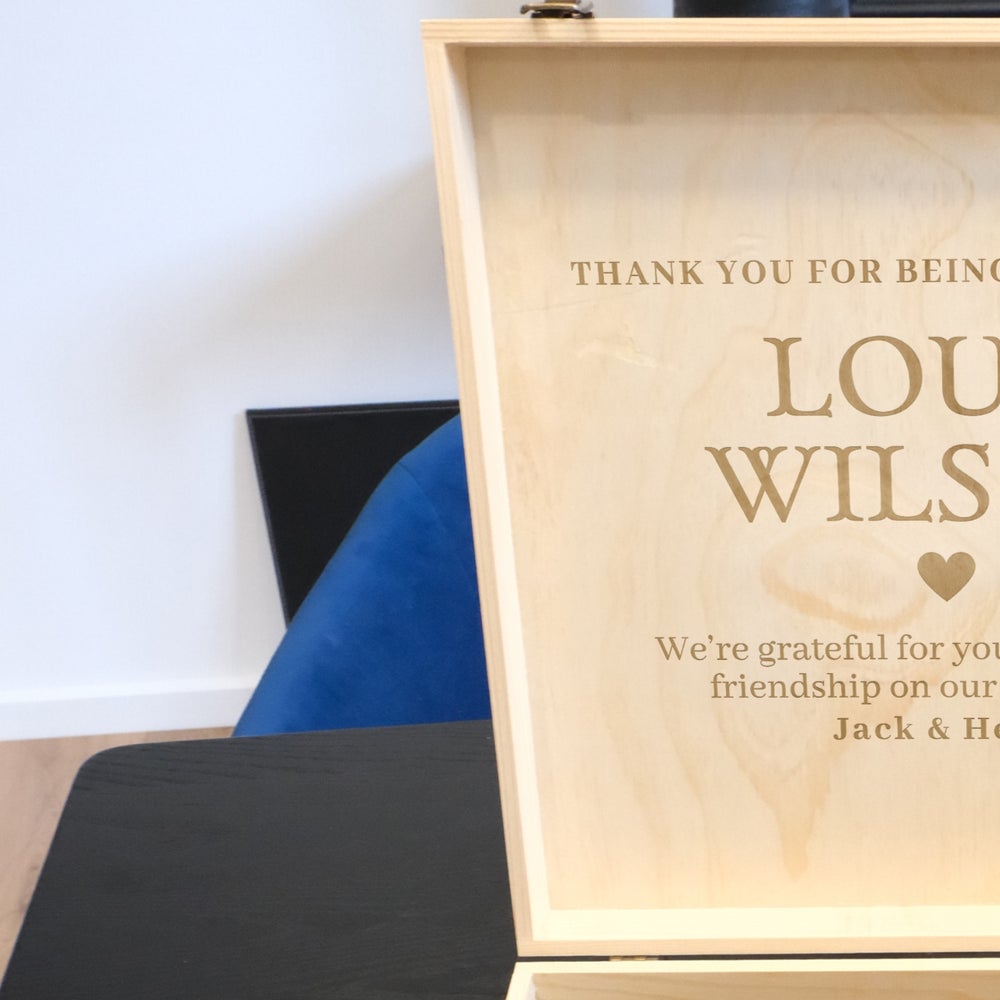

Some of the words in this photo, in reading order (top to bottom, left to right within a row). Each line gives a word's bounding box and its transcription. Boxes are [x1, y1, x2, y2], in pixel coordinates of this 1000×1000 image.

[570, 260, 704, 286] THANK
[715, 259, 794, 285] YOU
[807, 258, 883, 284] FOR
[654, 634, 749, 661] We’re
[758, 633, 888, 668] grateful
[897, 633, 945, 661] for
[710, 672, 881, 706] friendship
[890, 679, 931, 699] on
[940, 680, 998, 698] our
[832, 715, 915, 741] Jack
[927, 717, 950, 740] &
